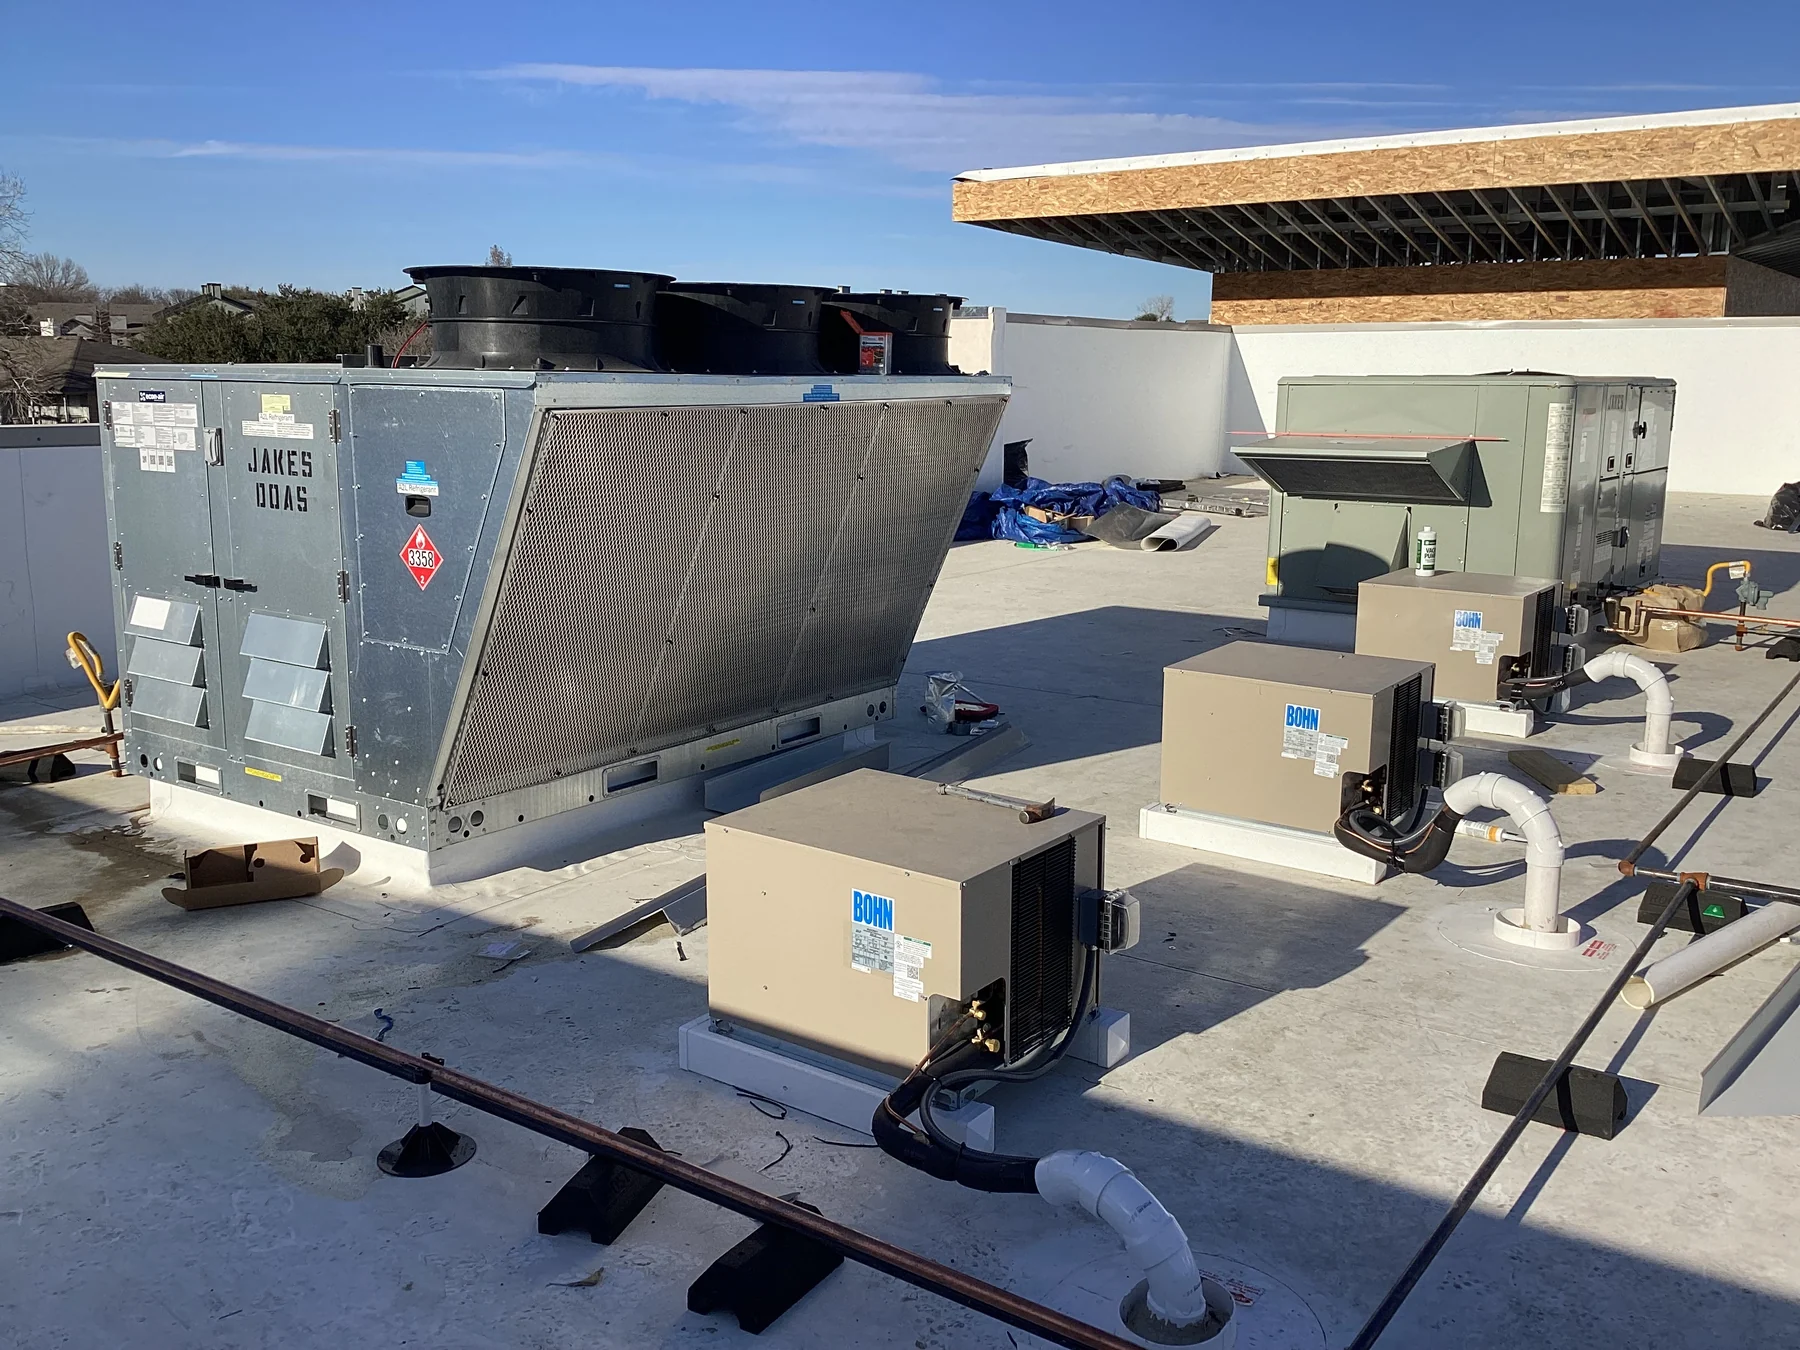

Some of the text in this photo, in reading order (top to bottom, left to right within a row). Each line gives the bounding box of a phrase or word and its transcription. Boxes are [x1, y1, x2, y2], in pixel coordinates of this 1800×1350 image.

[269, 413, 293, 423] Refrigerant
[248, 447, 313, 478] JAKES
[256, 482, 308, 512] DOAS
[409, 484, 437, 494] Refrigerant
[409, 549, 434, 568] 3358
[420, 575, 425, 584] 2
[1456, 611, 1481, 628] BOHN
[1286, 705, 1319, 731] BOHN
[853, 890, 893, 931] BOHN
